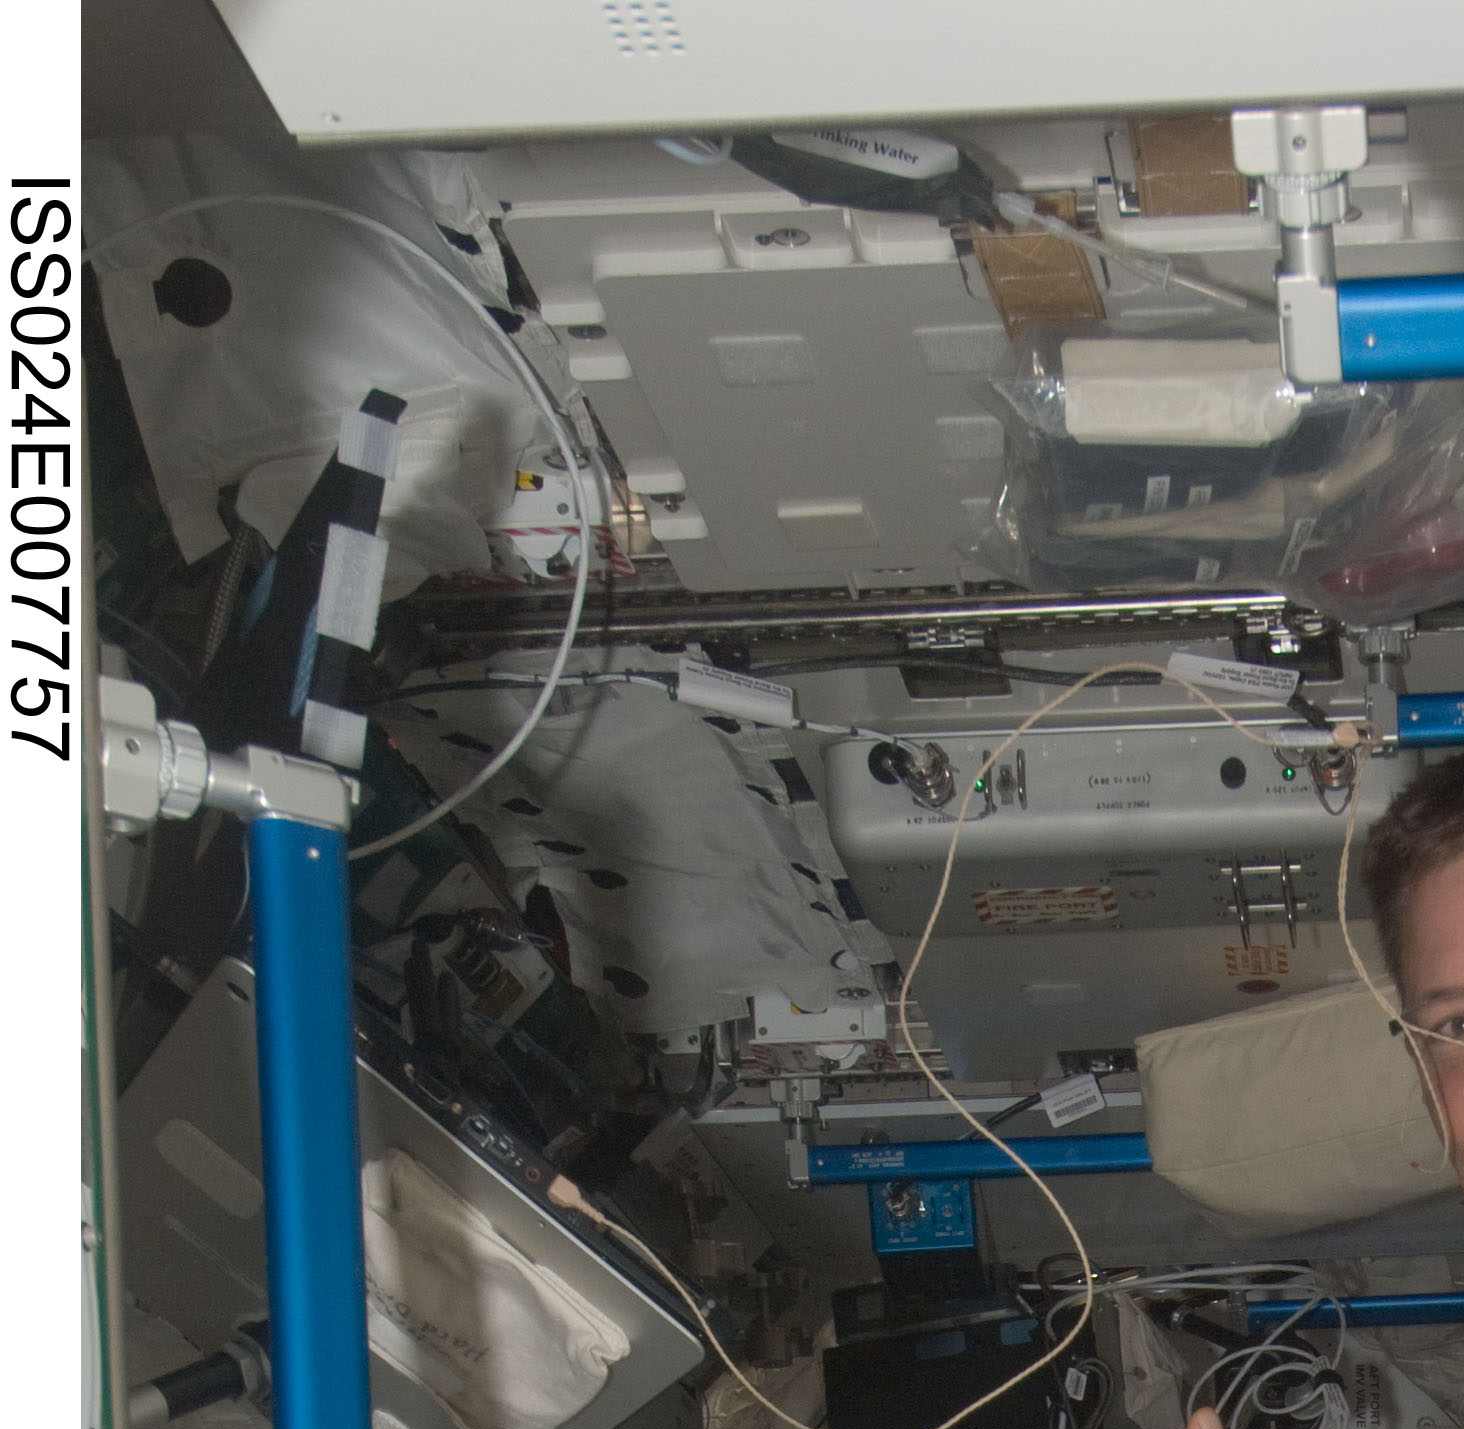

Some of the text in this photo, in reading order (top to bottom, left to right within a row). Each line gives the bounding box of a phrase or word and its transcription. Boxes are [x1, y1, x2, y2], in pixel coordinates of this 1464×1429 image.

[813, 127, 920, 165] rinking Water
[995, 901, 1098, 911] FIRE PORT
[1355, 1364, 1367, 1428] IMV VALVE
[1369, 1364, 1381, 1427] AFT PORT
